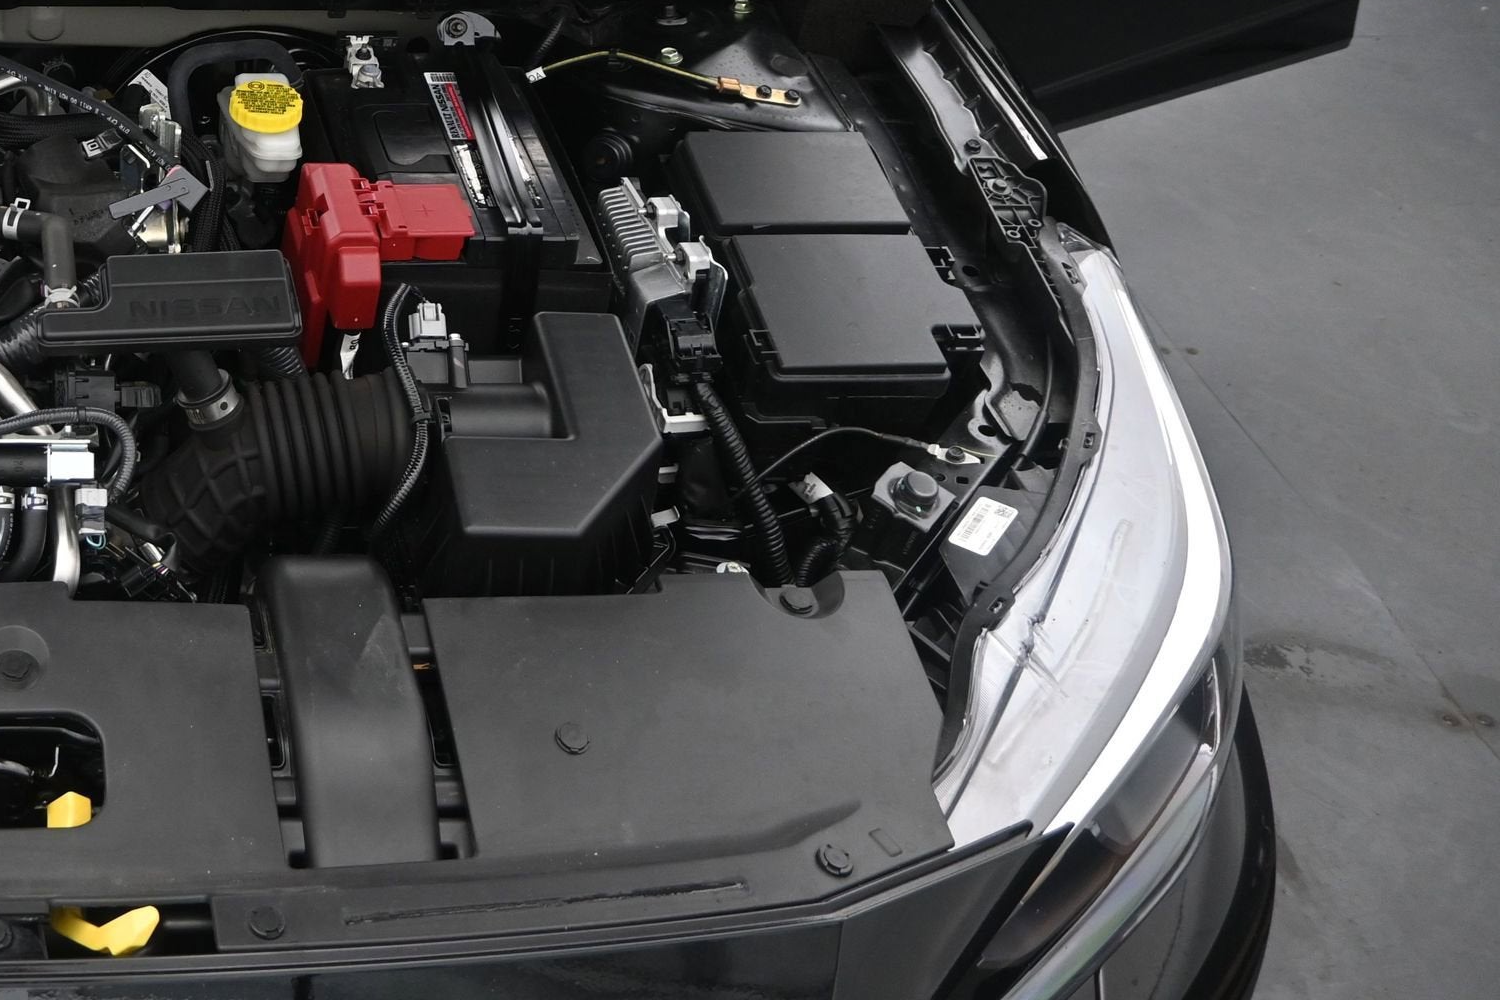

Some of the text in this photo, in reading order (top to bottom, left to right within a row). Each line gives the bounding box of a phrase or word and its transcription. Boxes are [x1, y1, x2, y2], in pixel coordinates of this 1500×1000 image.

[430, 84, 450, 111] NISSAN
[442, 113, 461, 139] RENAULT
[128, 296, 281, 318] NISSAN
